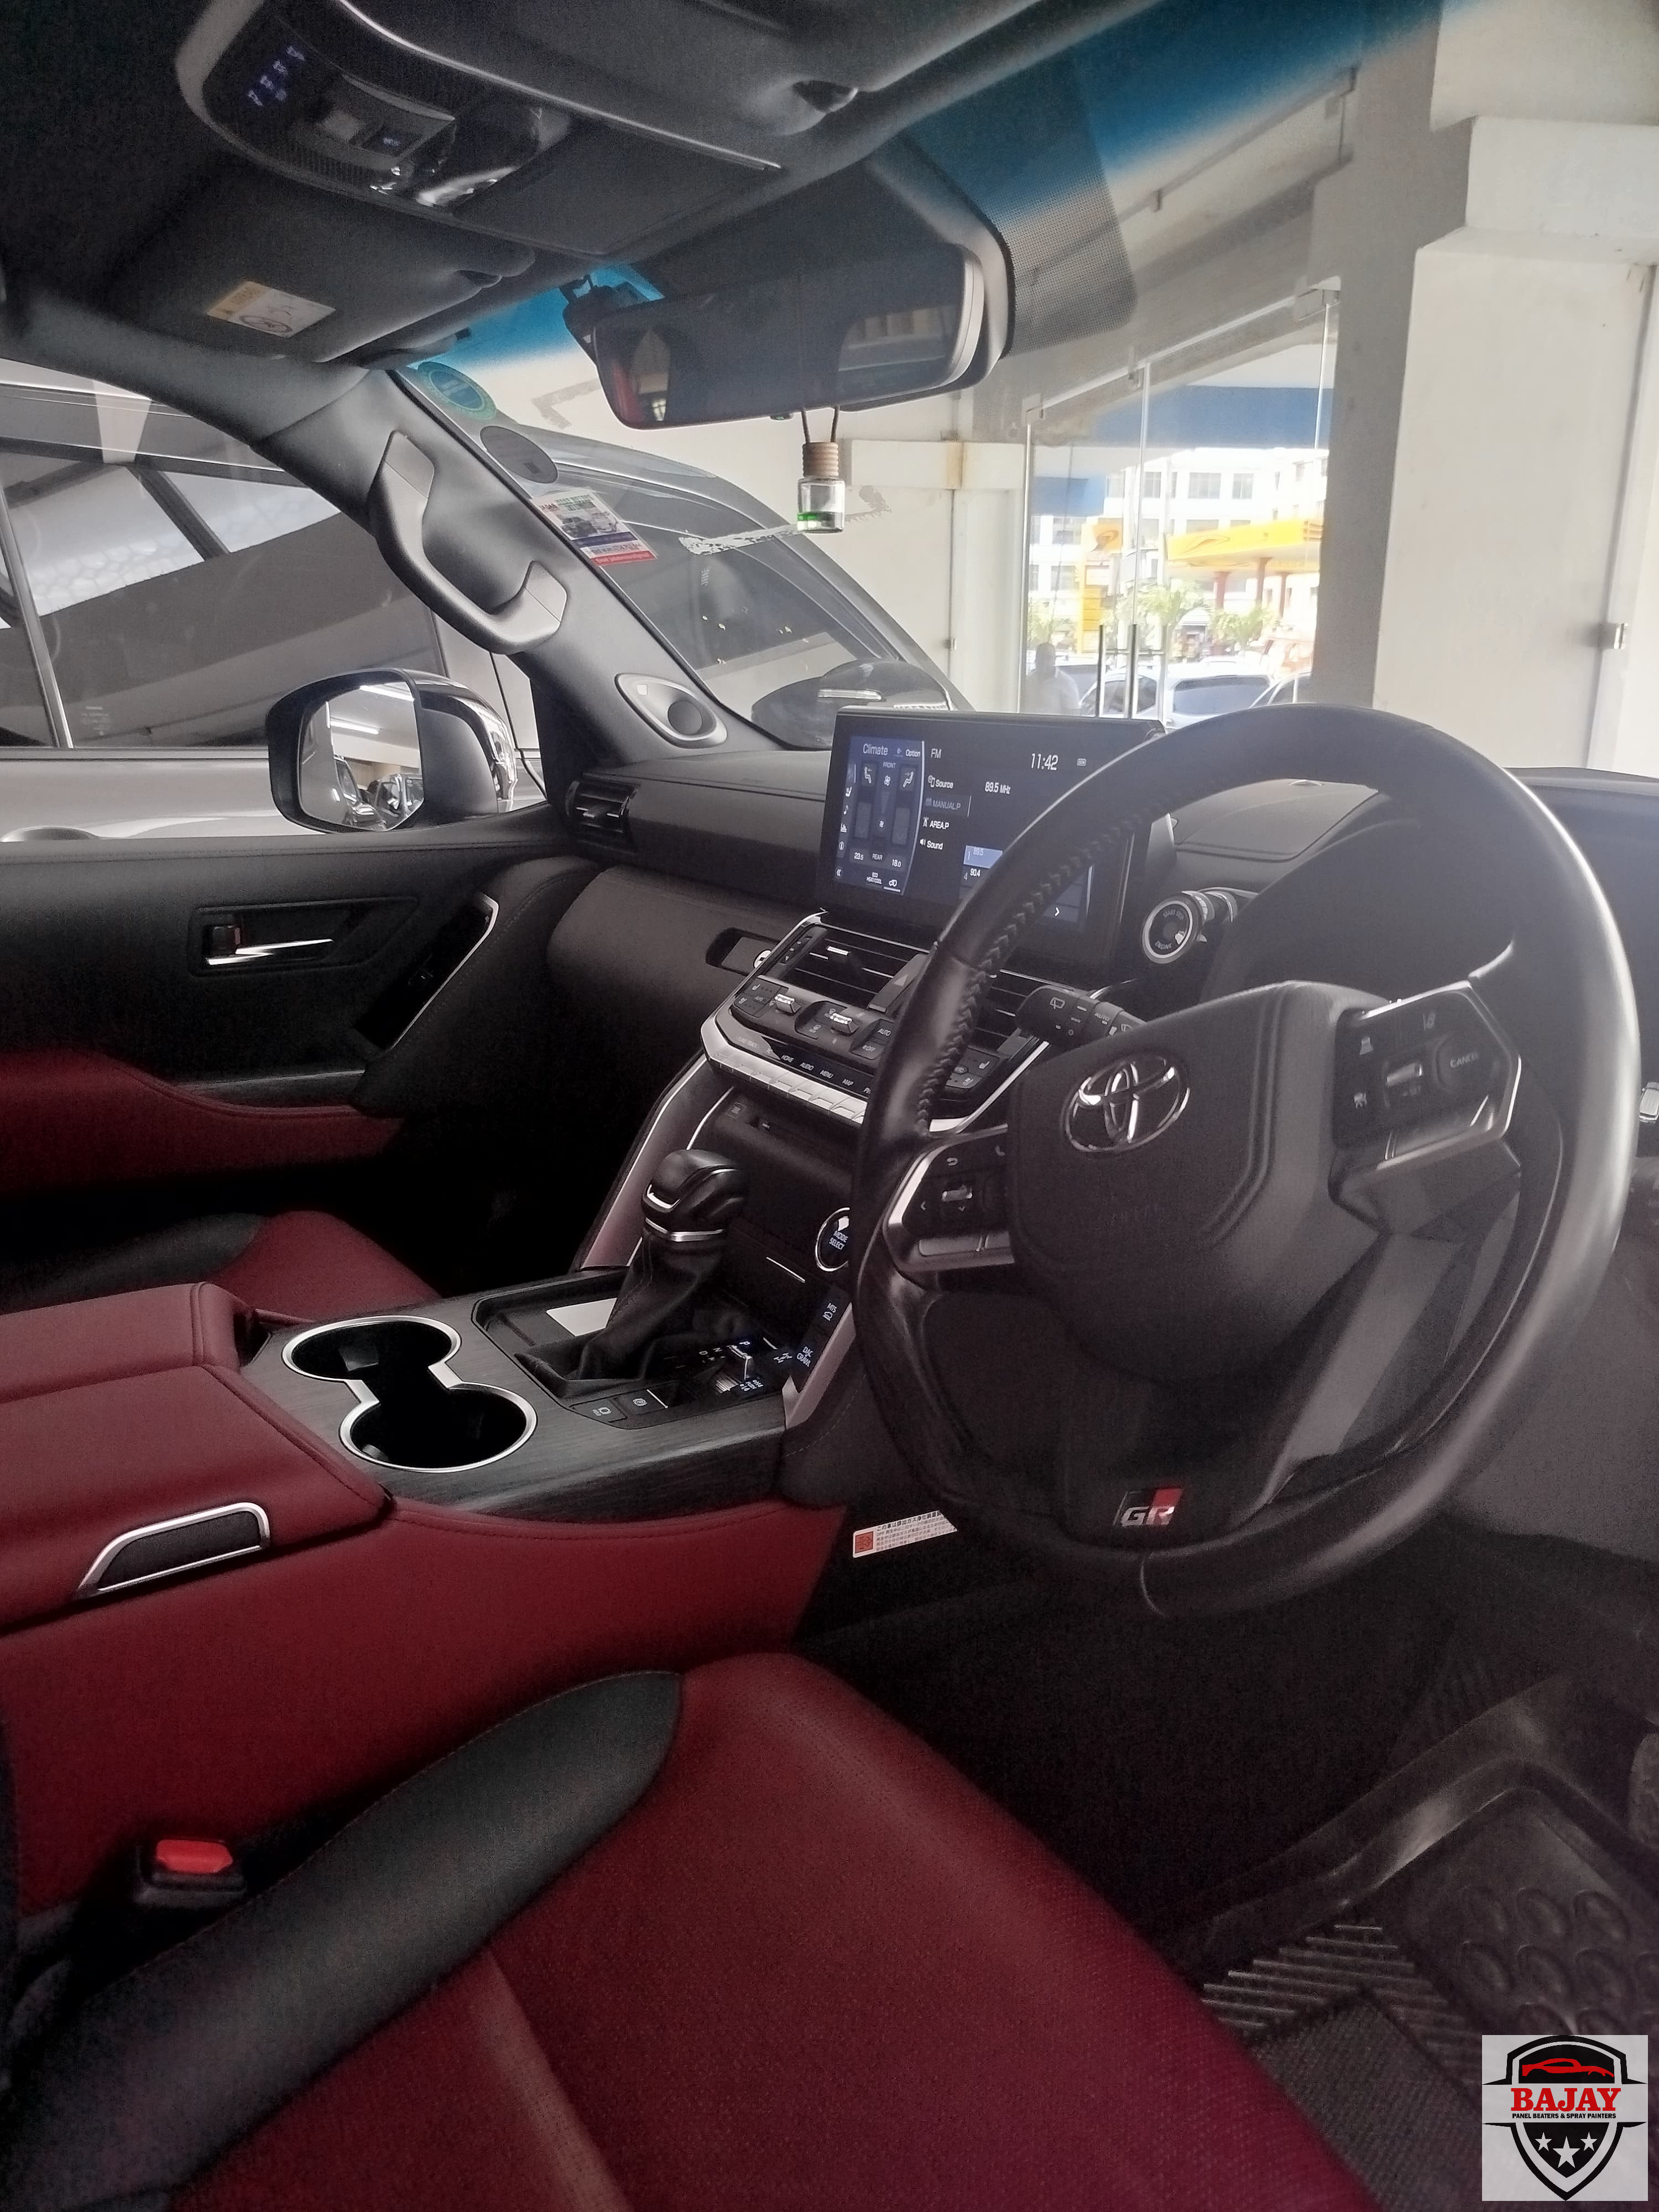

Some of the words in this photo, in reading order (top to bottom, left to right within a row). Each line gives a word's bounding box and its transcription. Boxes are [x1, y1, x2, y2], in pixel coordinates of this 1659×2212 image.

[863, 743, 888, 756] Climate
[931, 748, 942, 759] FM
[1031, 753, 1058, 770] 11:42
[935, 779, 954, 789] Source
[984, 781, 999, 792] 89.5
[999, 784, 1011, 794] MHz
[926, 841, 943, 850] Sound
[854, 852, 864, 860] 23.5
[892, 859, 901, 868] 18.0
[970, 868, 980, 877] 90.4
[781, 1055, 794, 1063] HOME
[800, 1062, 815, 1071] AUDIO
[820, 1070, 834, 1078] MENU
[830, 1238, 845, 1250] SELECT
[827, 1303, 837, 1313] MTS
[1120, 1504, 1175, 1527] GR
